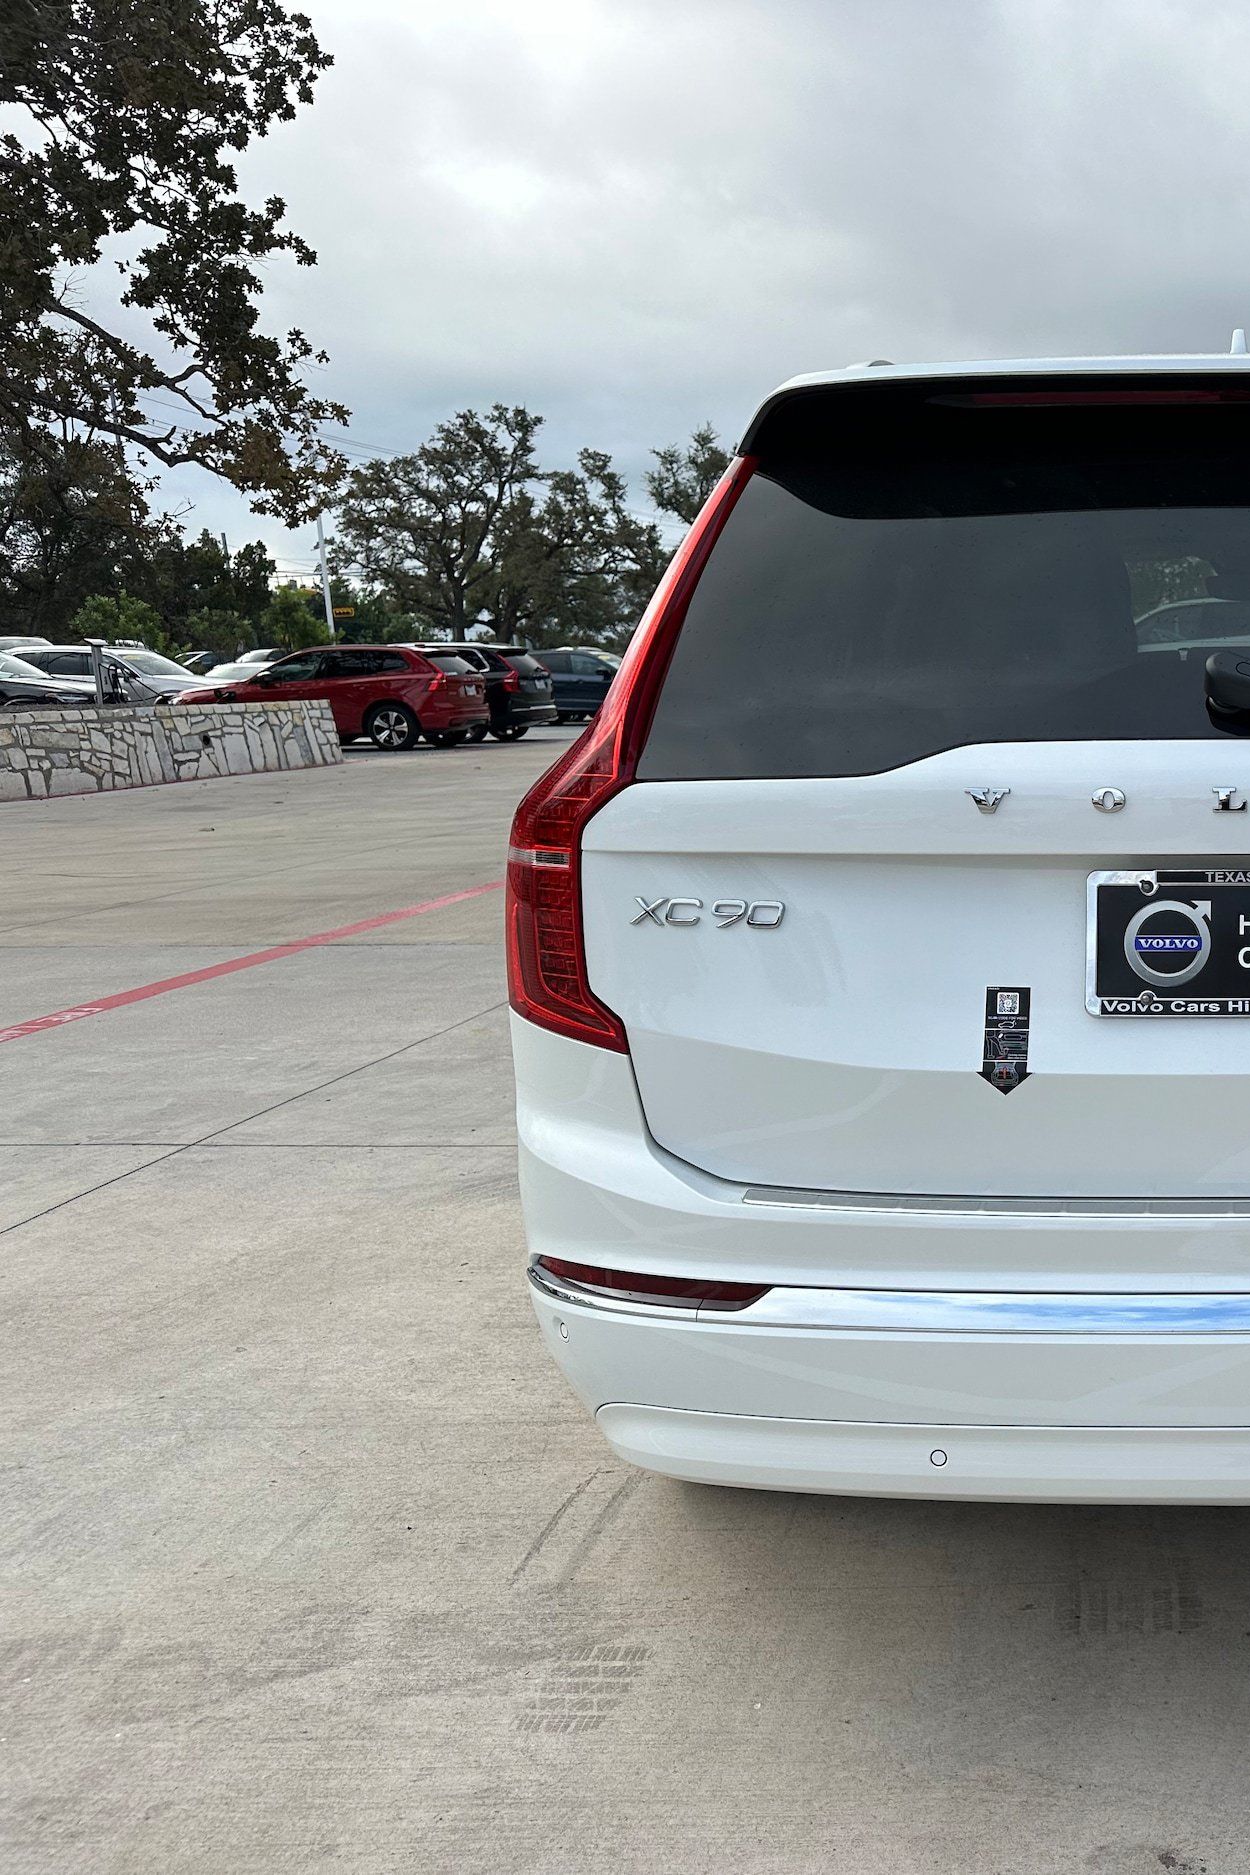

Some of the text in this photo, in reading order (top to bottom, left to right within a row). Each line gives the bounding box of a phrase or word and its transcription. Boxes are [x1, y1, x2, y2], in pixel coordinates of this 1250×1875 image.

[1138, 938, 1199, 949] VOLVO
[1102, 1000, 1164, 1013] Volvo
[1170, 1000, 1220, 1013] Cars
